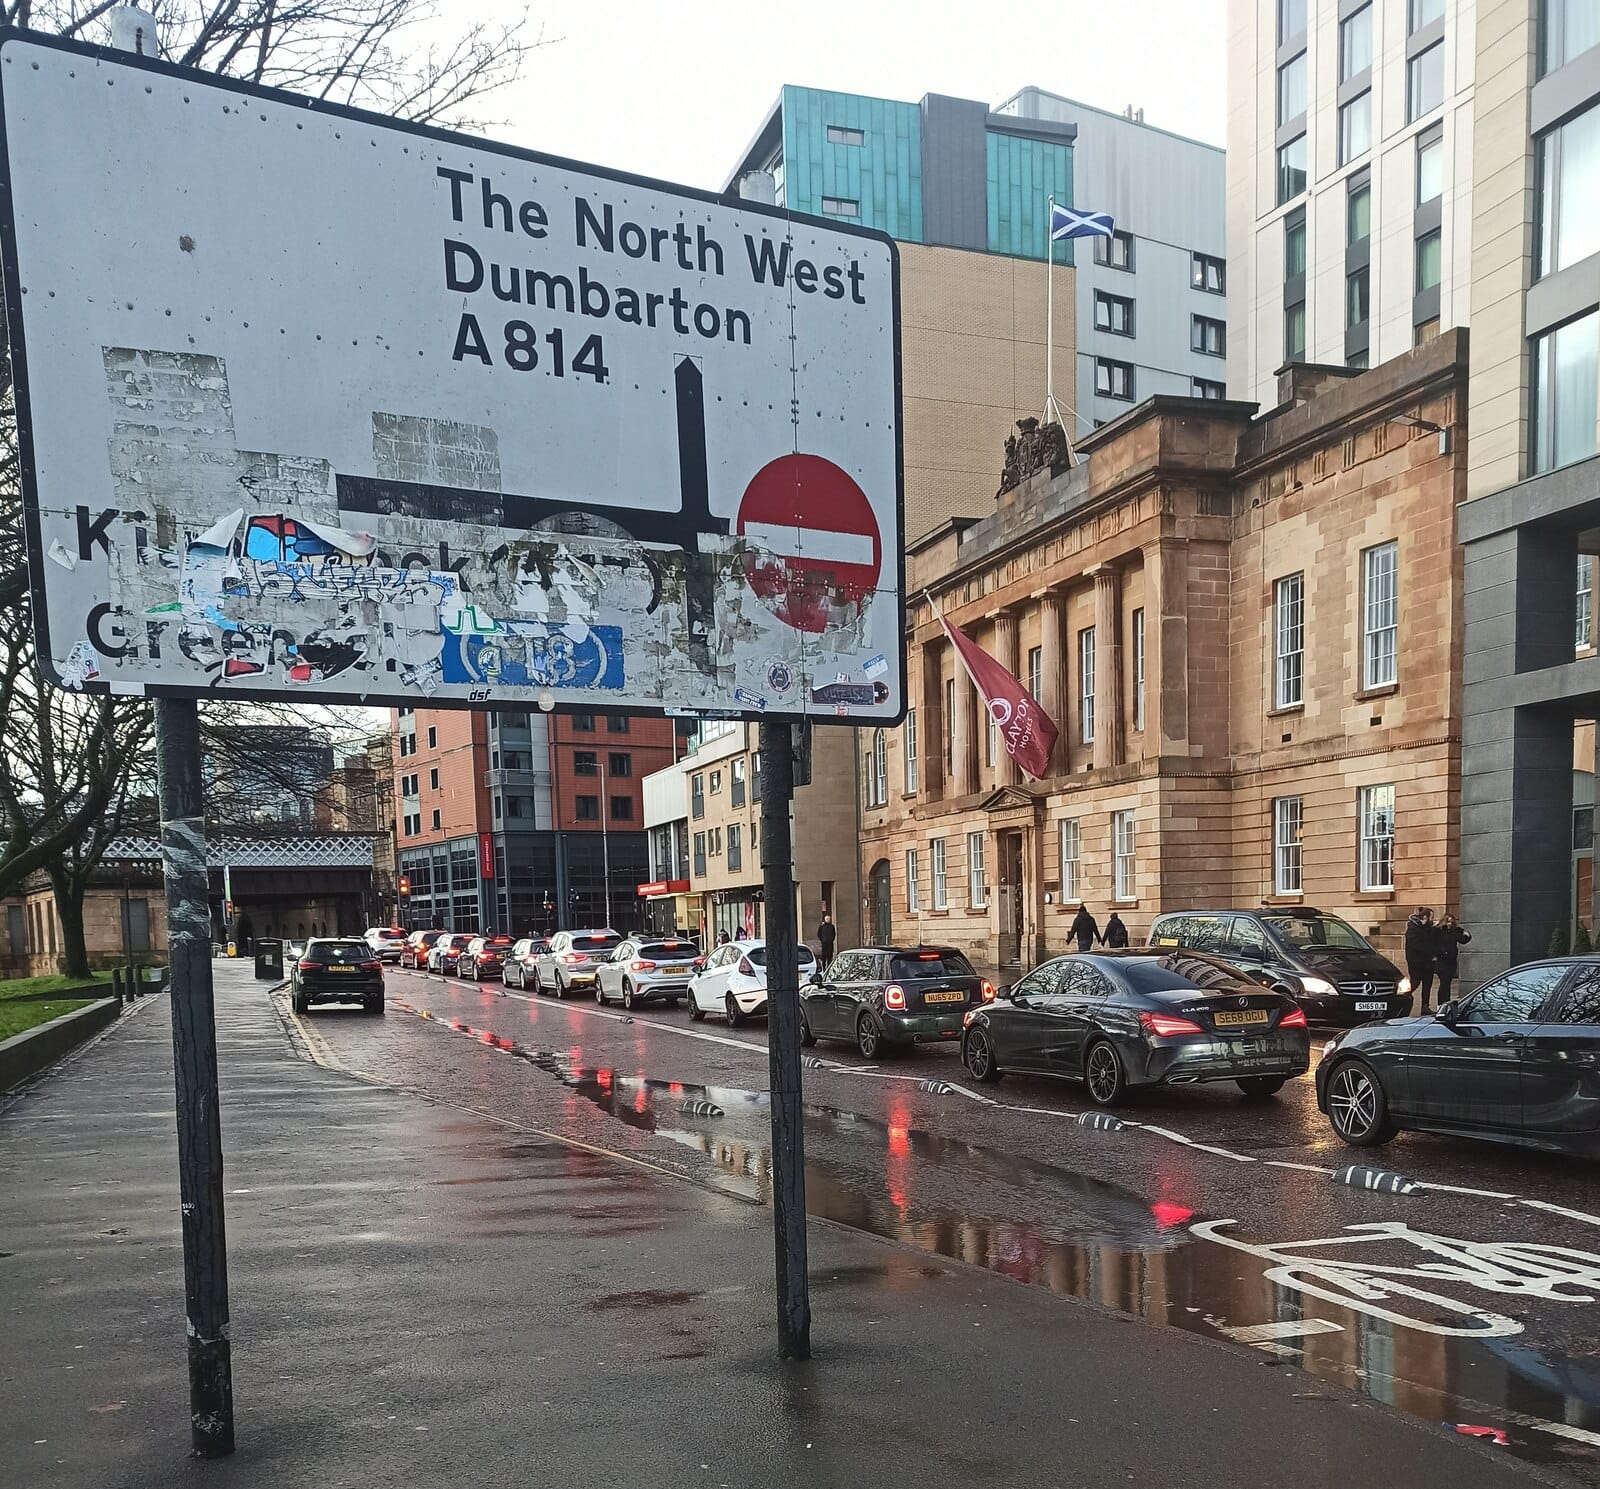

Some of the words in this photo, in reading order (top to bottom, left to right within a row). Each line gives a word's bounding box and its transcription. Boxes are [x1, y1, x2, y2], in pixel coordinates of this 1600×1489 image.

[437, 166, 549, 239] The
[575, 197, 725, 276] North
[743, 233, 867, 305] West
[443, 238, 753, 345] Dumbarton
[452, 312, 610, 385] A814
[469, 688, 492, 701] dsf
[1005, 698, 1029, 754] CLAYTON
[1019, 716, 1033, 749] HOTELS
[1219, 1013, 1243, 1024] SE68
